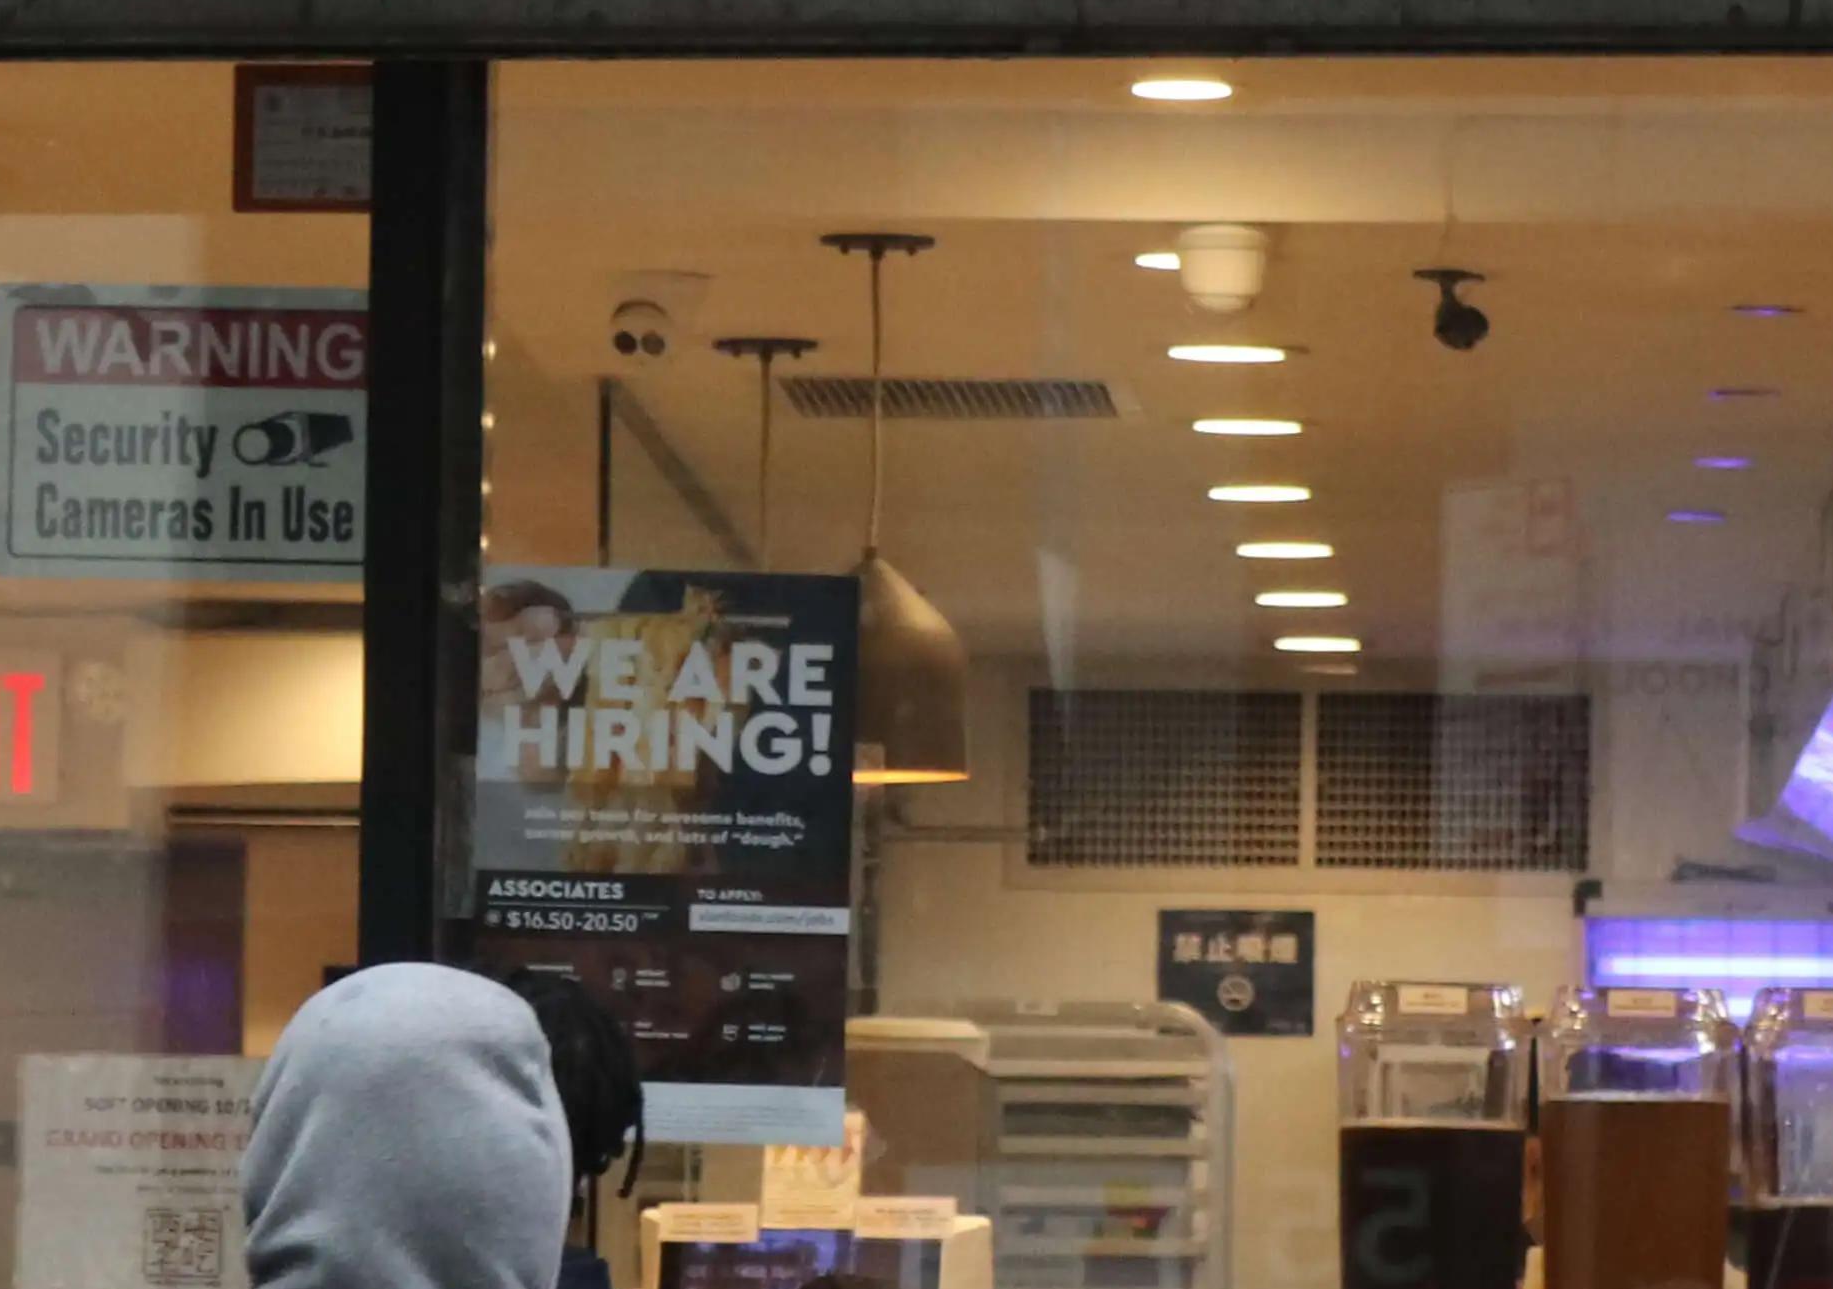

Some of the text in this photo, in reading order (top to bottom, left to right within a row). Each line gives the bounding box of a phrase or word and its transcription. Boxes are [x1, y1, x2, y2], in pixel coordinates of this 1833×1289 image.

[34, 318, 366, 381] WARNING
[34, 408, 217, 478] Security
[34, 482, 354, 543] Cameras In Use
[505, 636, 834, 708] WE ARE
[503, 704, 833, 776] HIRING!
[487, 879, 625, 901] ASSOCIATES
[506, 910, 639, 933] $16.50-20.50
[131, 1097, 211, 1115] OPENING
[129, 1130, 226, 1152] OPENING
